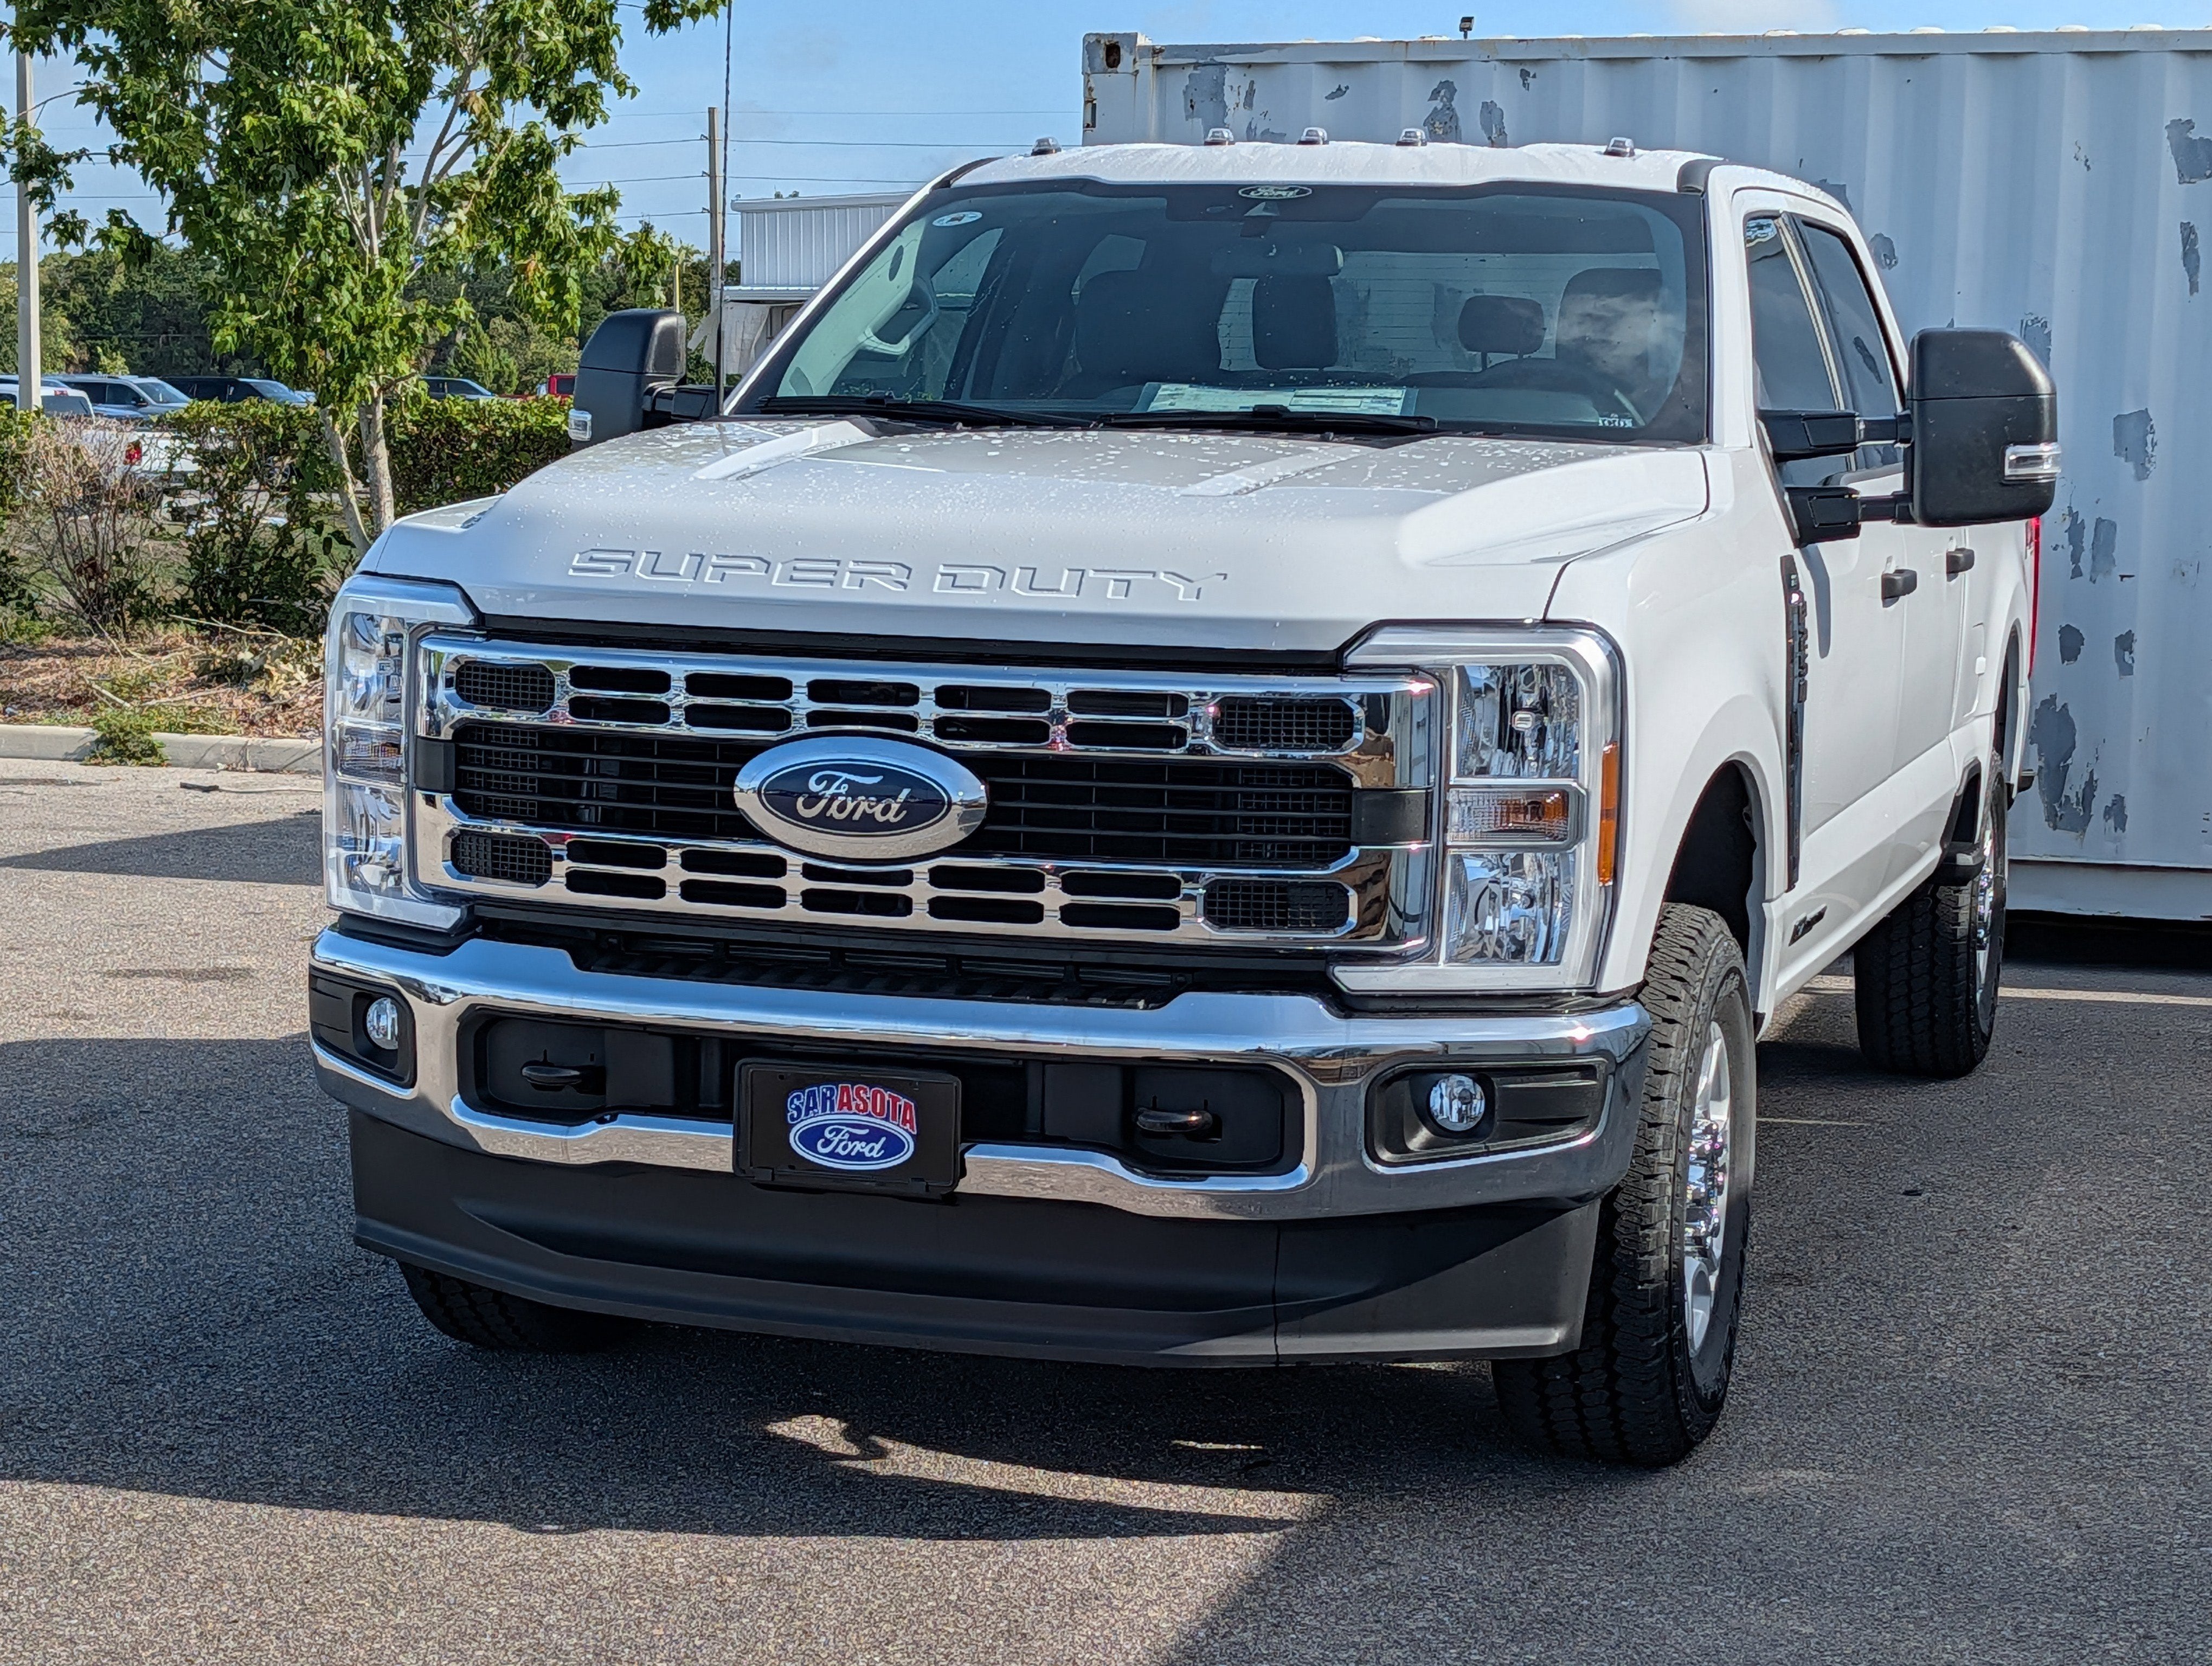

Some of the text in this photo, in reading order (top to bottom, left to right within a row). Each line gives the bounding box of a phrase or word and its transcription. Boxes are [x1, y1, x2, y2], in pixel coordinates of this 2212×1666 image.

[568, 548, 1227, 601] SUPER DUTY
[796, 770, 911, 823] Ford
[787, 1084, 917, 1135] SARASOTA
[817, 1125, 886, 1158] Ford
